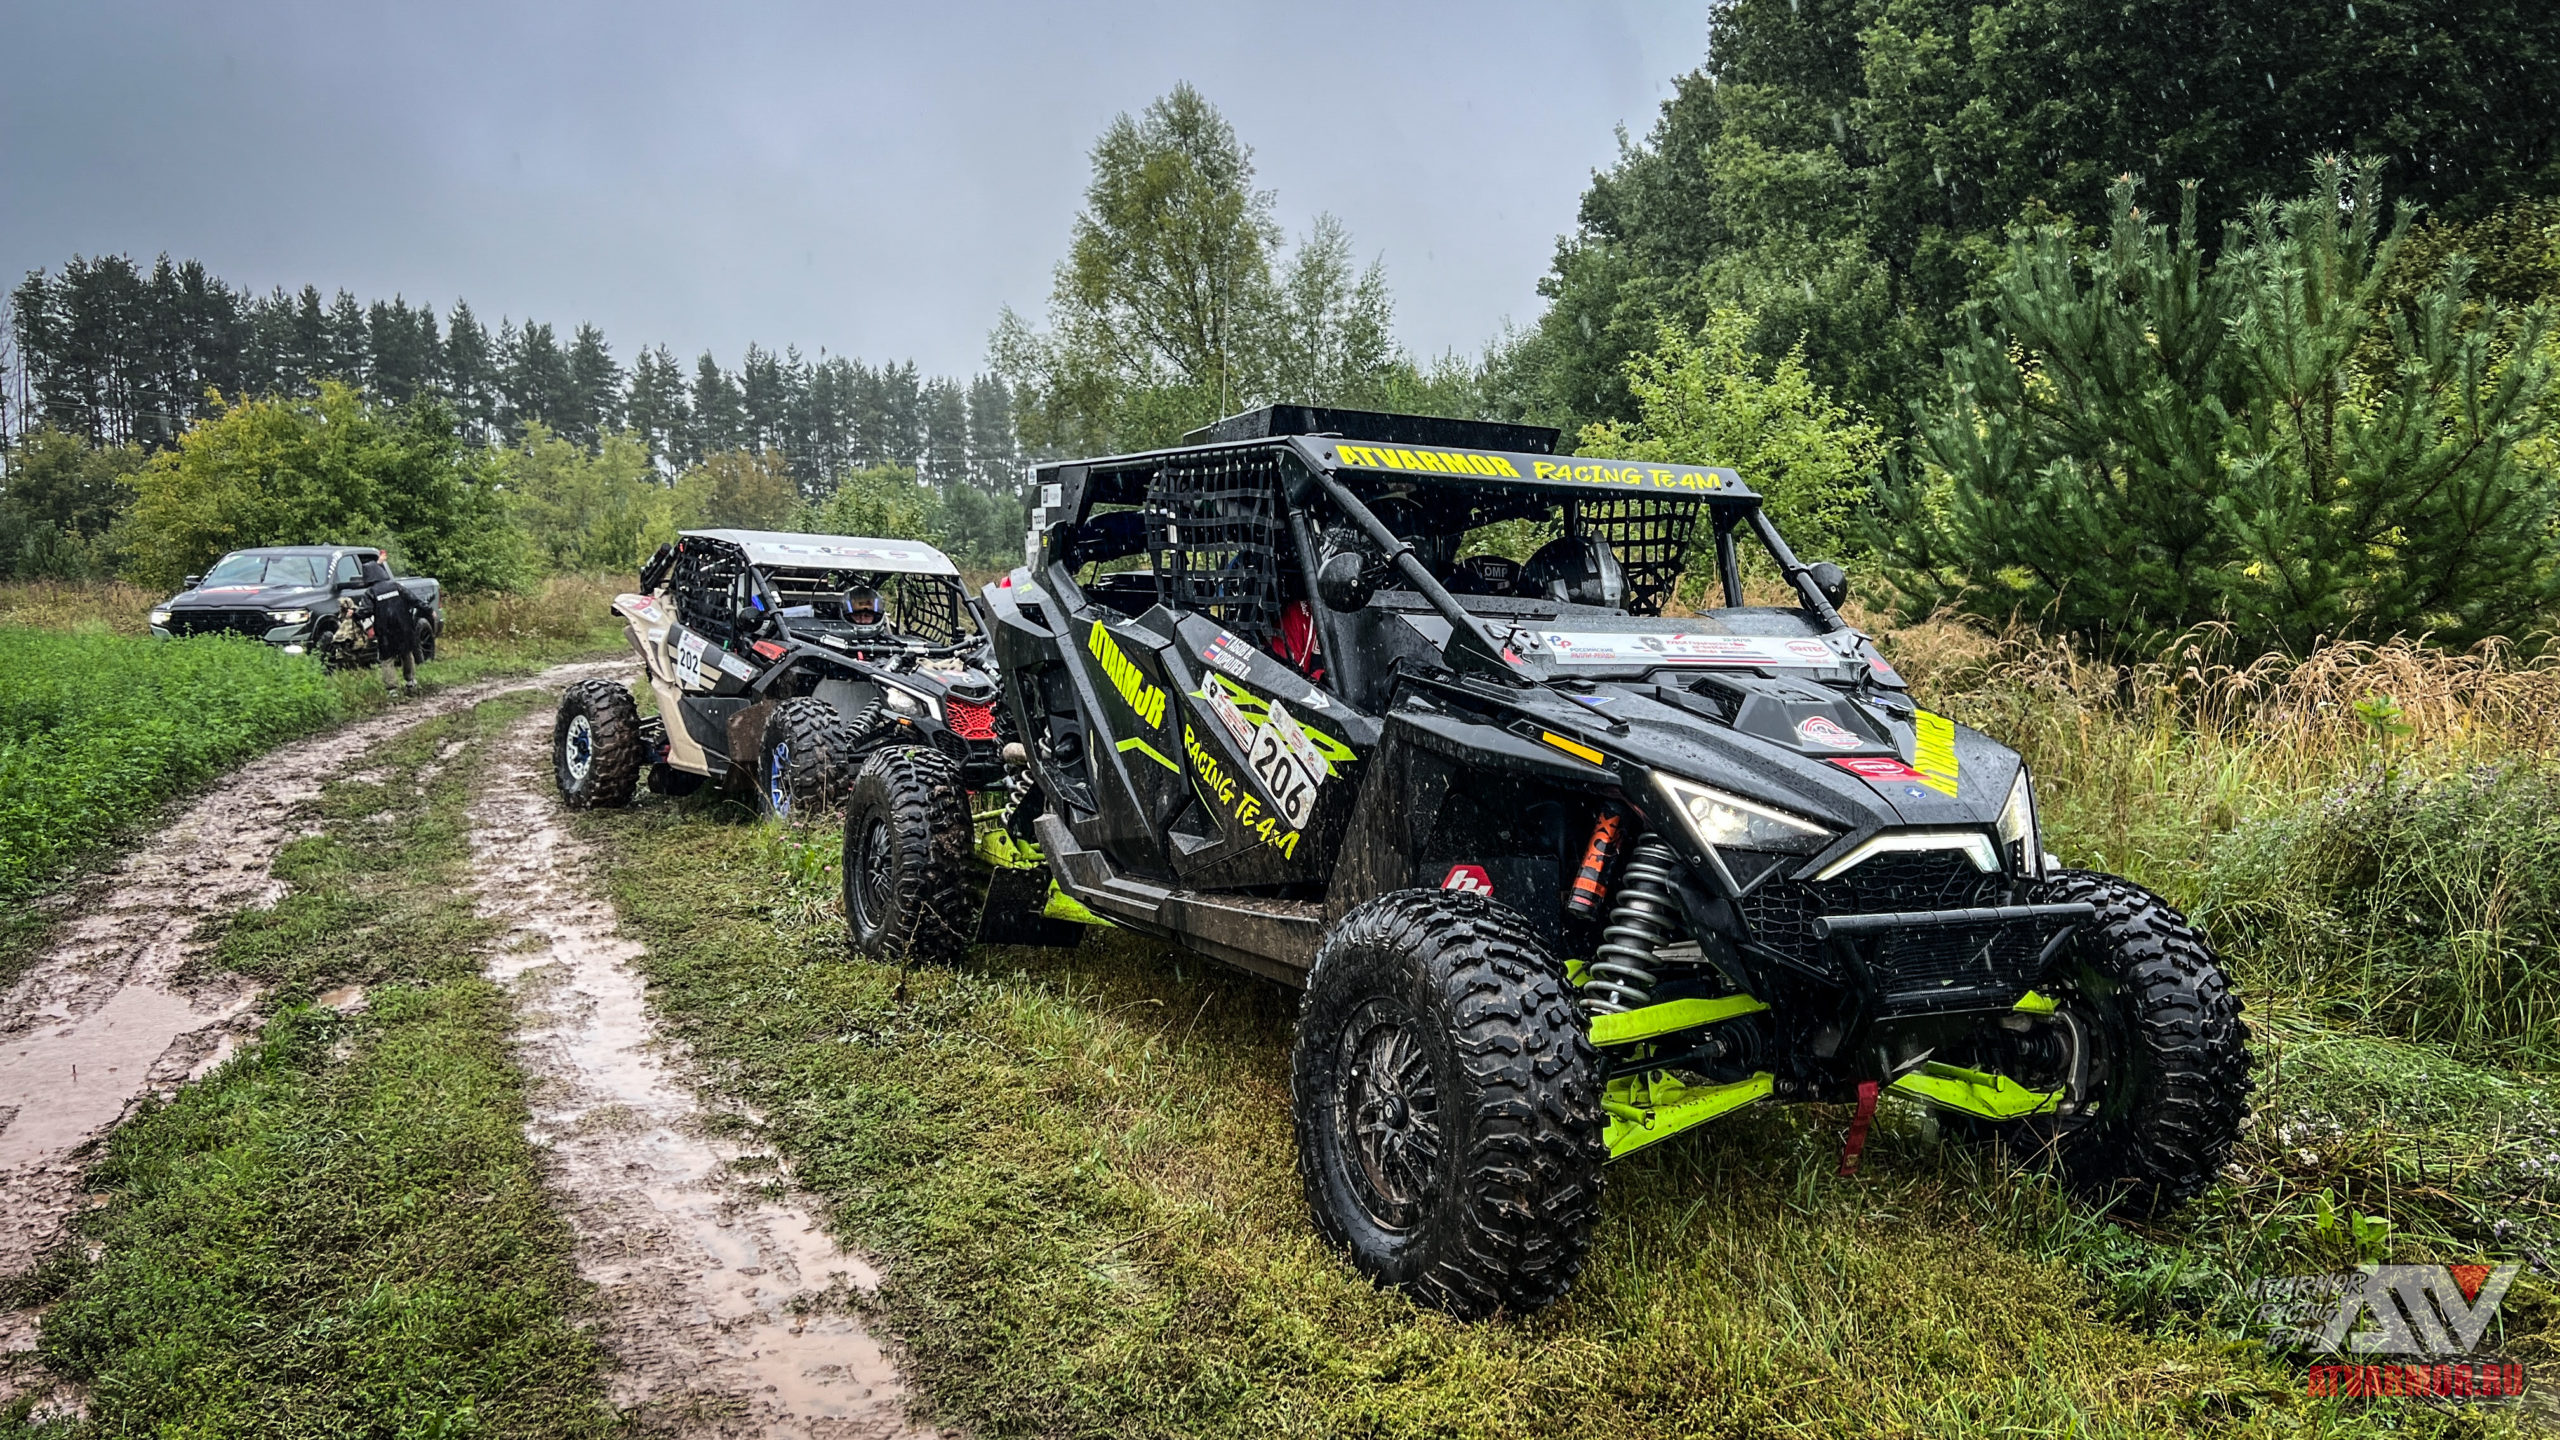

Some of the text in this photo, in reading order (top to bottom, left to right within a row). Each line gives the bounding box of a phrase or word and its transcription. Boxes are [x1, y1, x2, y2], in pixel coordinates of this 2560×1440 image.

[1335, 445, 1722, 491] ATVARMOR RACING TEAM
[1484, 566, 1508, 578] OMP
[680, 648, 699, 675] 202
[1184, 723, 1235, 805] RACING
[1234, 792, 1300, 860] TEAM
[1254, 737, 1307, 820] 206
